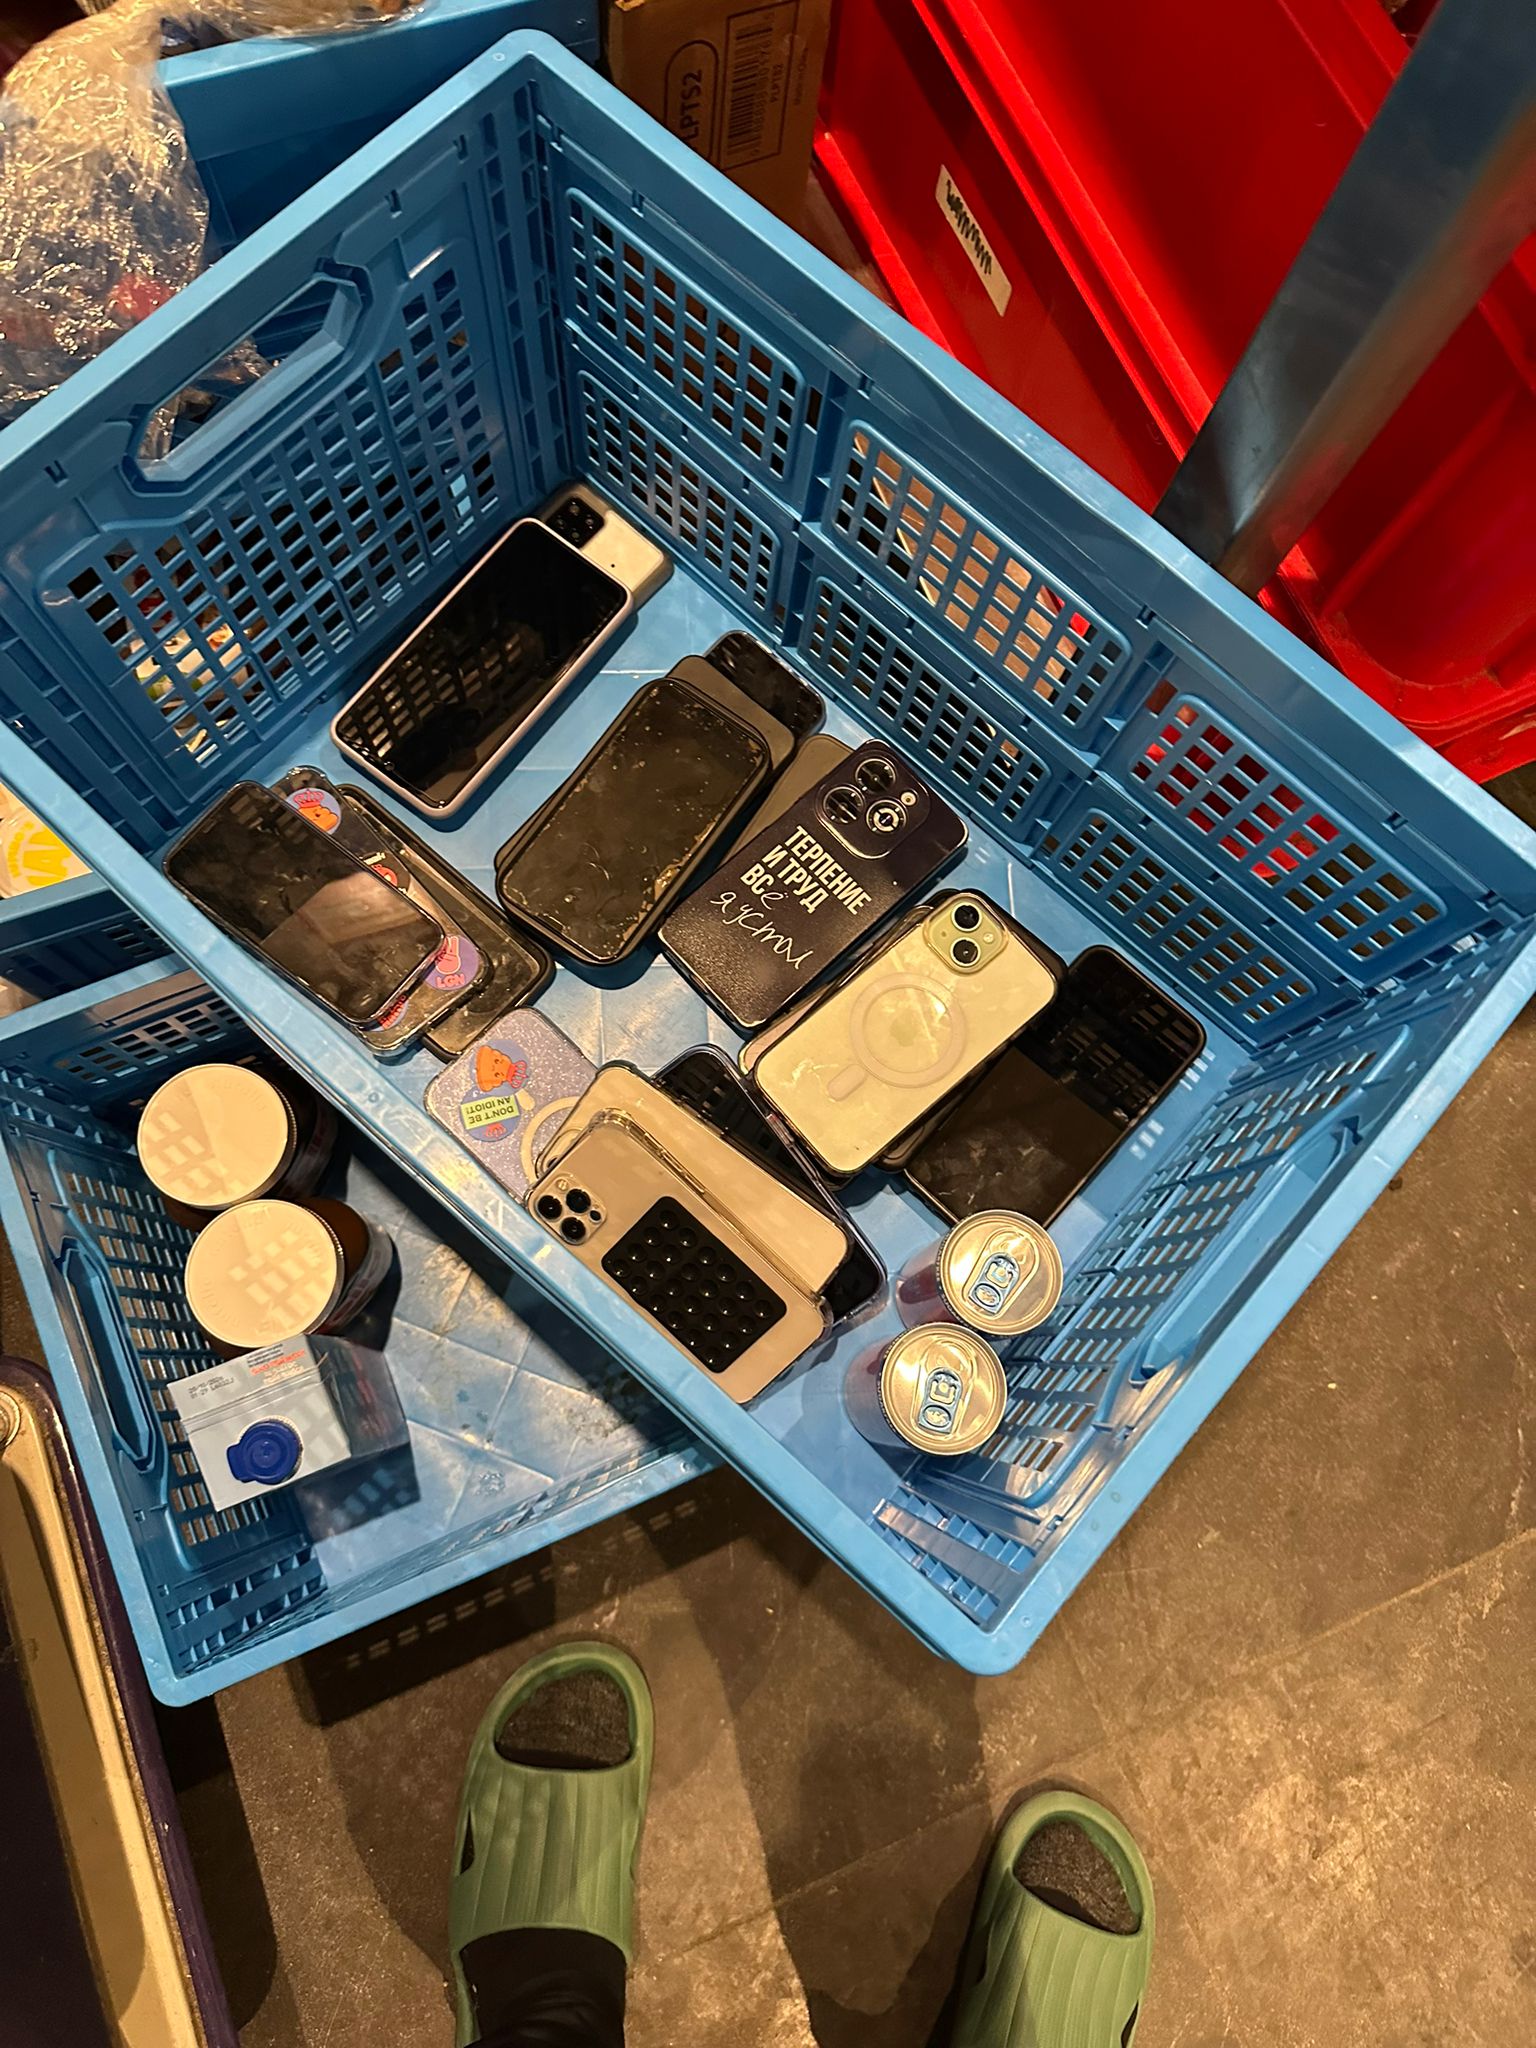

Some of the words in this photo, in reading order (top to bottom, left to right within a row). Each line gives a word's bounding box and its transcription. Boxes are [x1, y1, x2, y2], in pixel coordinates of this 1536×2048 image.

[680, 68, 703, 143] LPTS2
[762, 844, 788, 869] И
[777, 857, 829, 914] ТРУД
[785, 825, 872, 915] ТЕРПЕНИЕ
[722, 904, 814, 970] устал
[465, 1100, 496, 1114] IDIOT!
[468, 1114, 482, 1124] BE
[484, 1105, 514, 1120] DON'T
[497, 1096, 511, 1106] AN
